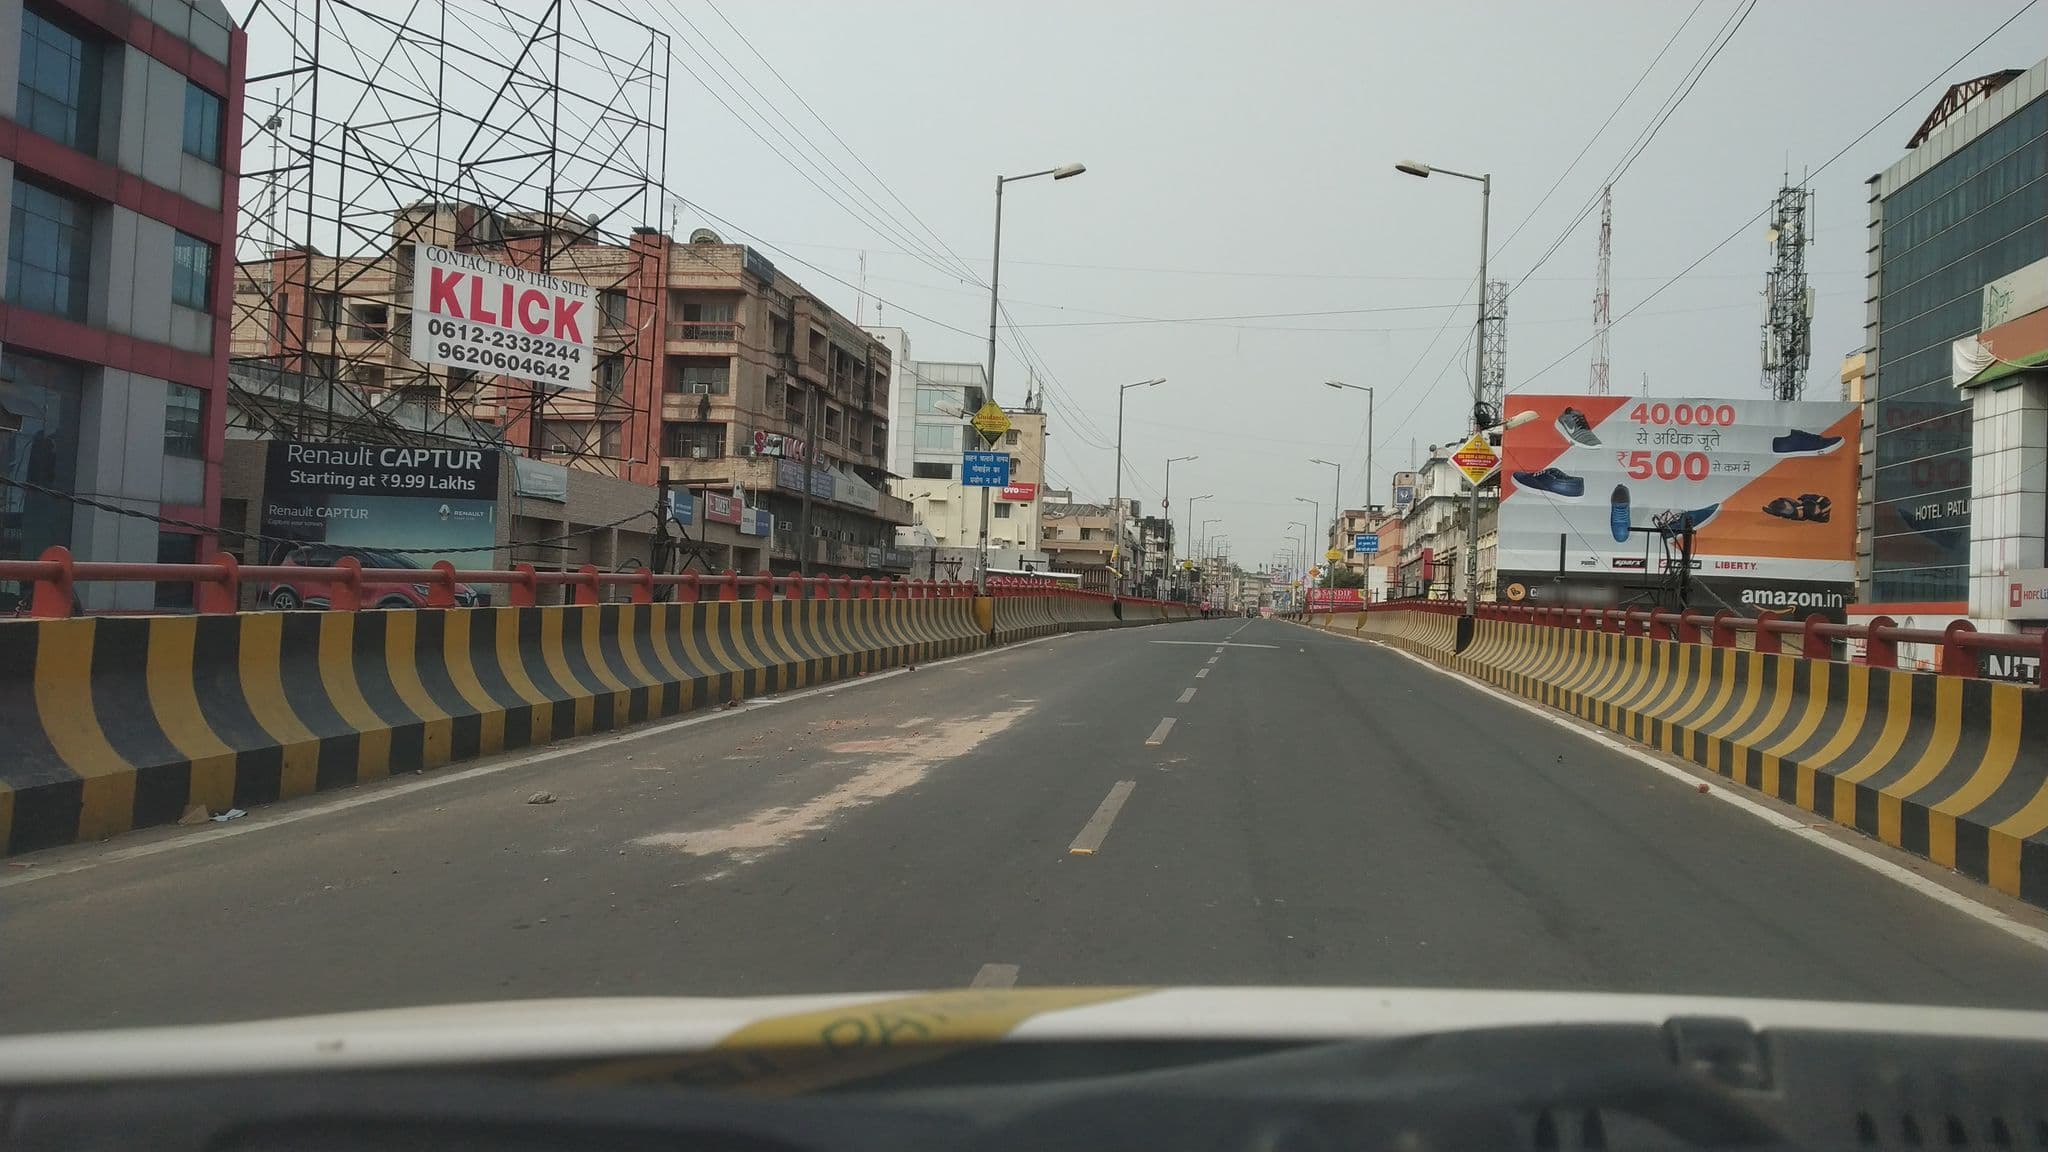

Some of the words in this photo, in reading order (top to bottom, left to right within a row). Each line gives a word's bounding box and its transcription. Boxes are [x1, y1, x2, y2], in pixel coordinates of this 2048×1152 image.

[426, 247, 495, 274] CONTACT
[498, 264, 526, 282] FOR
[529, 272, 559, 291] THIS
[561, 280, 589, 299] SITE
[429, 266, 584, 344] KLICK
[428, 319, 581, 364] 0612-2332244
[437, 342, 570, 381] 9620604642
[1630, 402, 1736, 427] 40,000
[1636, 428, 1649, 445] से
[1653, 428, 1694, 446] अधिक
[1697, 429, 1721, 451] जूते
[288, 444, 374, 467] Renault
[379, 448, 482, 470] CAPTUR
[1616, 451, 1710, 481] ₹500
[1712, 460, 1721, 472] से
[1723, 463, 1741, 473] कम
[290, 470, 355, 489] Starting
[359, 474, 375, 487] at
[380, 473, 425, 488] ₹9.99
[429, 475, 476, 491] Lakhs
[269, 504, 314, 517] Renault
[316, 507, 369, 520] CAPTUR
[1915, 503, 1943, 520] HOTEL
[1741, 588, 1842, 608] amazon.in
